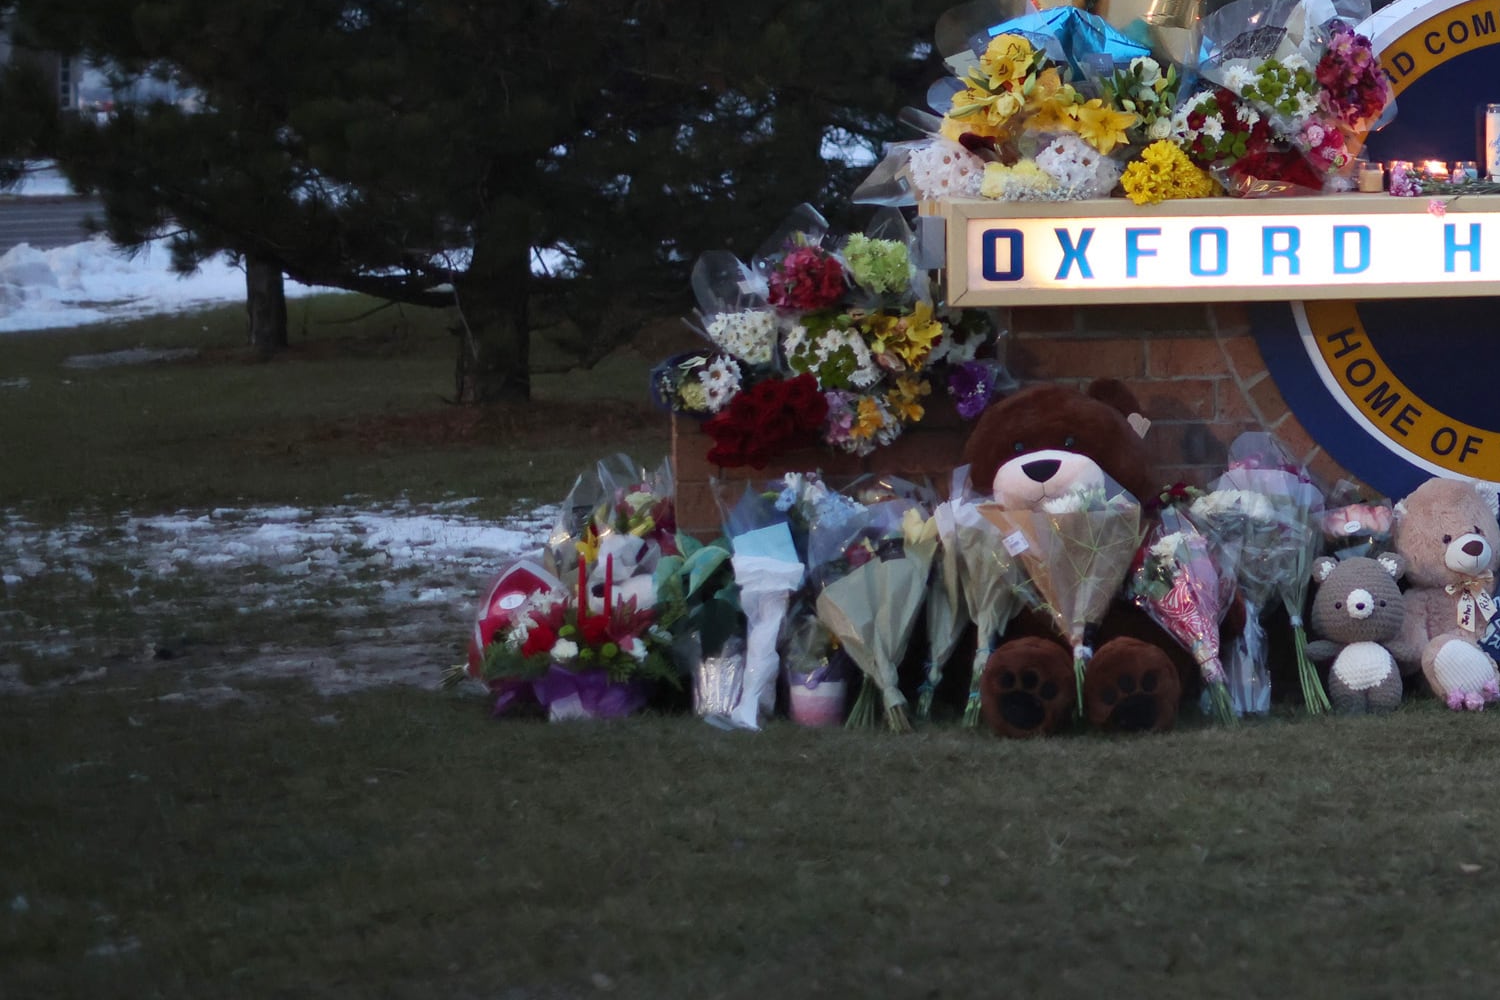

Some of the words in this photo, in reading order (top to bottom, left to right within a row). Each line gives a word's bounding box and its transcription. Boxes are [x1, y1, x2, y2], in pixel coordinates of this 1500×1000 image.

[982, 224, 1371, 282] OXFORD
[1327, 327, 1422, 437] HOME
[1431, 427, 1483, 463] OF
[1461, 604, 1473, 626] John
